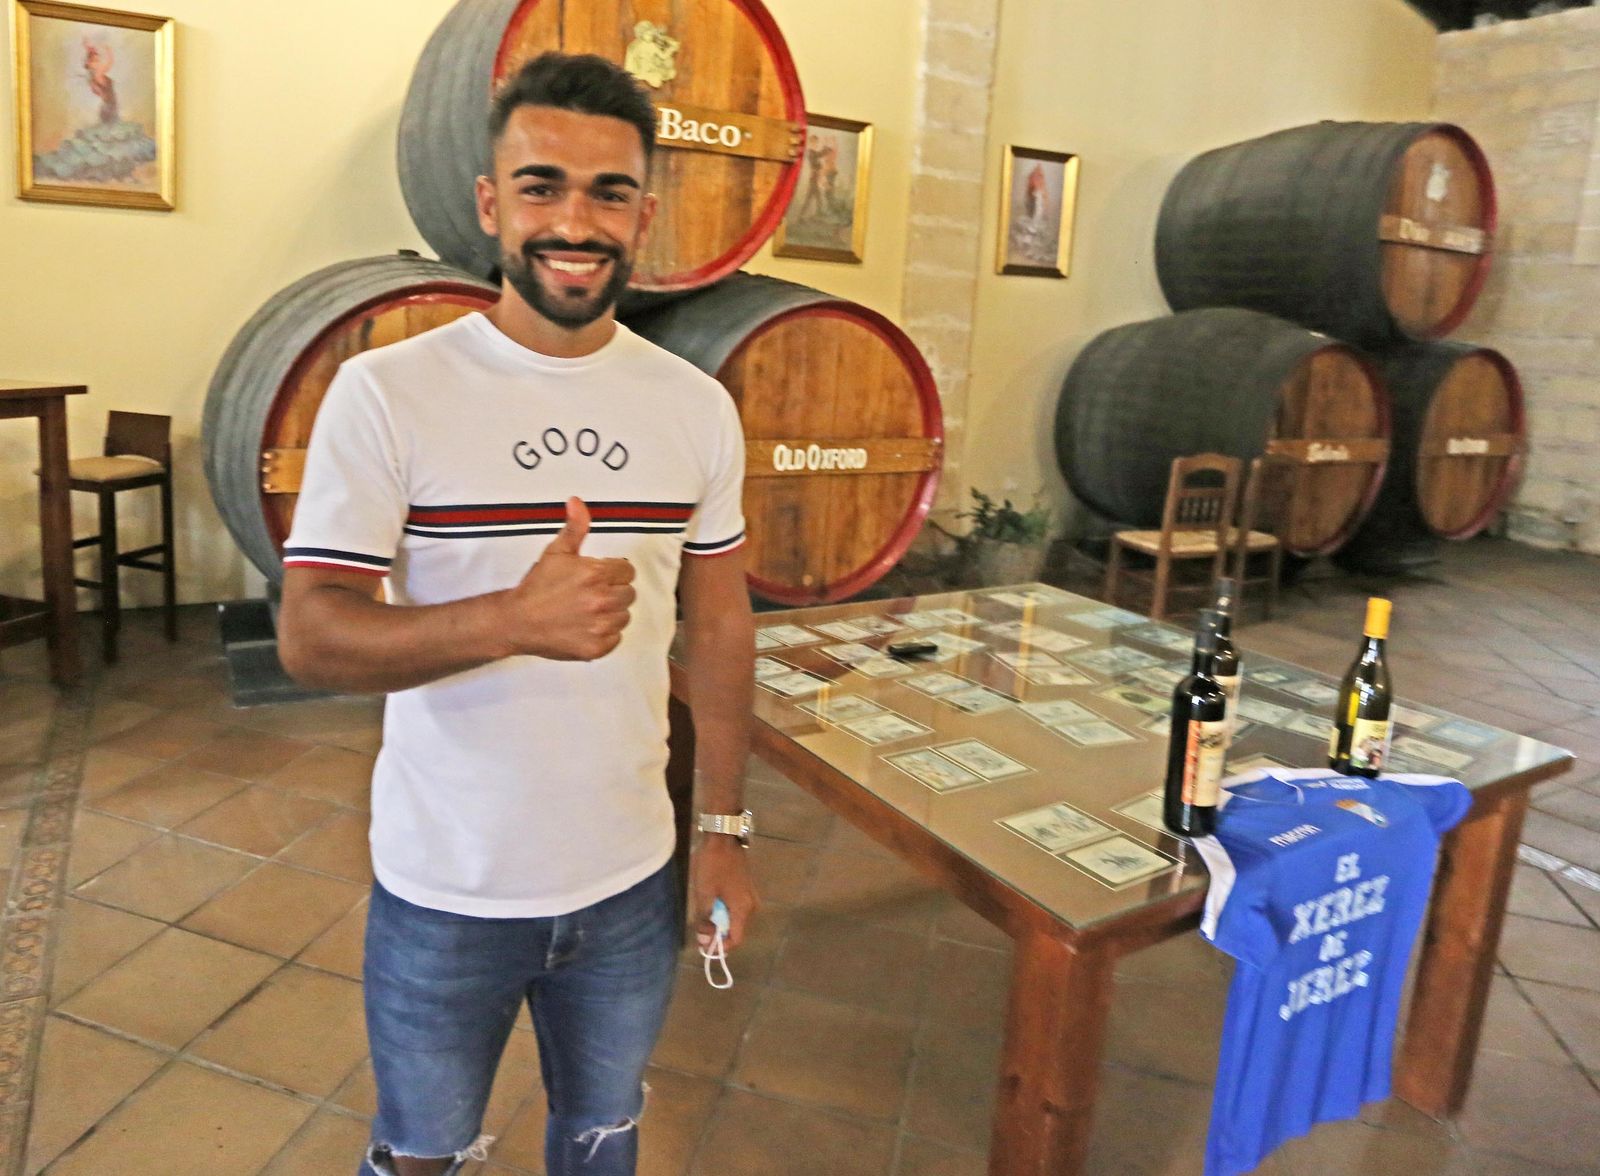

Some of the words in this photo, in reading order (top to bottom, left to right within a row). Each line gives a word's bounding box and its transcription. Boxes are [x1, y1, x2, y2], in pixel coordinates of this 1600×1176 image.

[657, 107, 742, 147] Baco
[513, 427, 629, 471] GOOD
[1288, 874, 1391, 945] XEREZ
